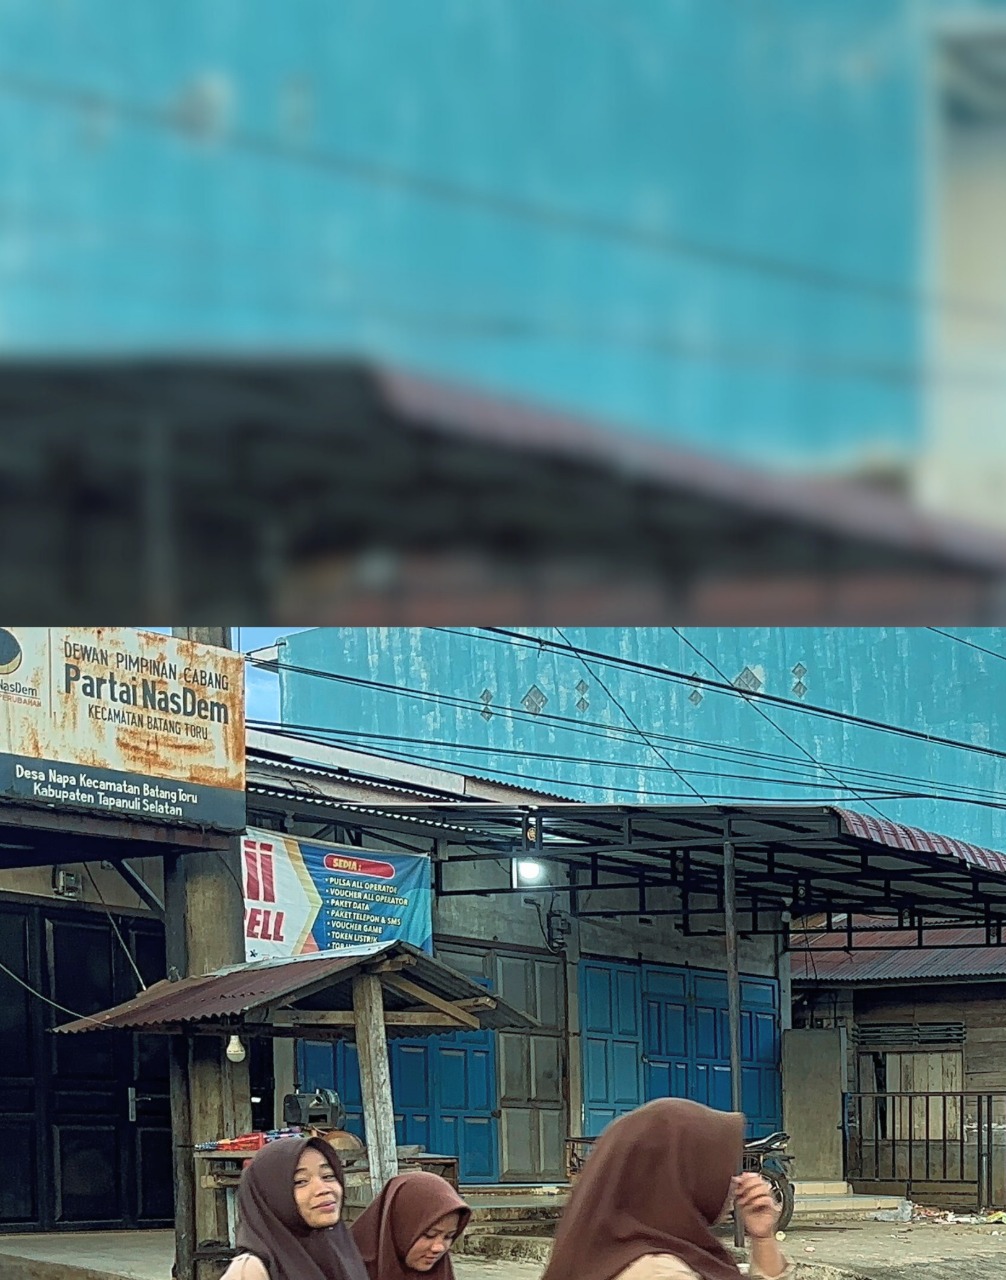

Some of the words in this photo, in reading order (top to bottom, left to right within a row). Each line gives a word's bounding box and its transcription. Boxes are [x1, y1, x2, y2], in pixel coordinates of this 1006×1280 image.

[64, 641, 108, 666] DEWAN
[116, 653, 177, 680] PIMPINAN
[184, 668, 229, 691] CABANG
[0, 694, 41, 707] ERUBAHAN
[65, 663, 137, 707] Partai
[142, 678, 229, 724] NasDem
[88, 704, 144, 728] KECAMATAN
[147, 716, 181, 735] BATANG
[185, 723, 208, 740] TORU
[16, 764, 45, 781] Desa
[49, 769, 76, 786] Napa
[80, 774, 140, 796] Kecamatan
[143, 784, 177, 803] Batang
[178, 788, 198, 804] Toru
[34, 783, 94, 804] Kabupaten
[97, 791, 141, 811] Tapanuli
[143, 800, 183, 816] Selatan
[329, 876, 350, 887] PULSA
[351, 880, 364, 889] ALL
[364, 882, 398, 894] OPERATOR
[330, 887, 362, 899] VOUCHER
[363, 891, 375, 901] ALL
[375, 894, 408, 906] OPERATOR
[330, 899, 352, 909] PAKET
[352, 902, 370, 911] DATA
[244, 907, 285, 942] ELL
[330, 910, 353, 920] PAKET
[353, 912, 380, 923] TELEPON
[387, 917, 401, 926] SMS
[331, 920, 362, 931] VOUCHER
[363, 925, 383, 934] GAME
[331, 931, 353, 940] TOKEN
[354, 934, 378, 943] LISTRIK
